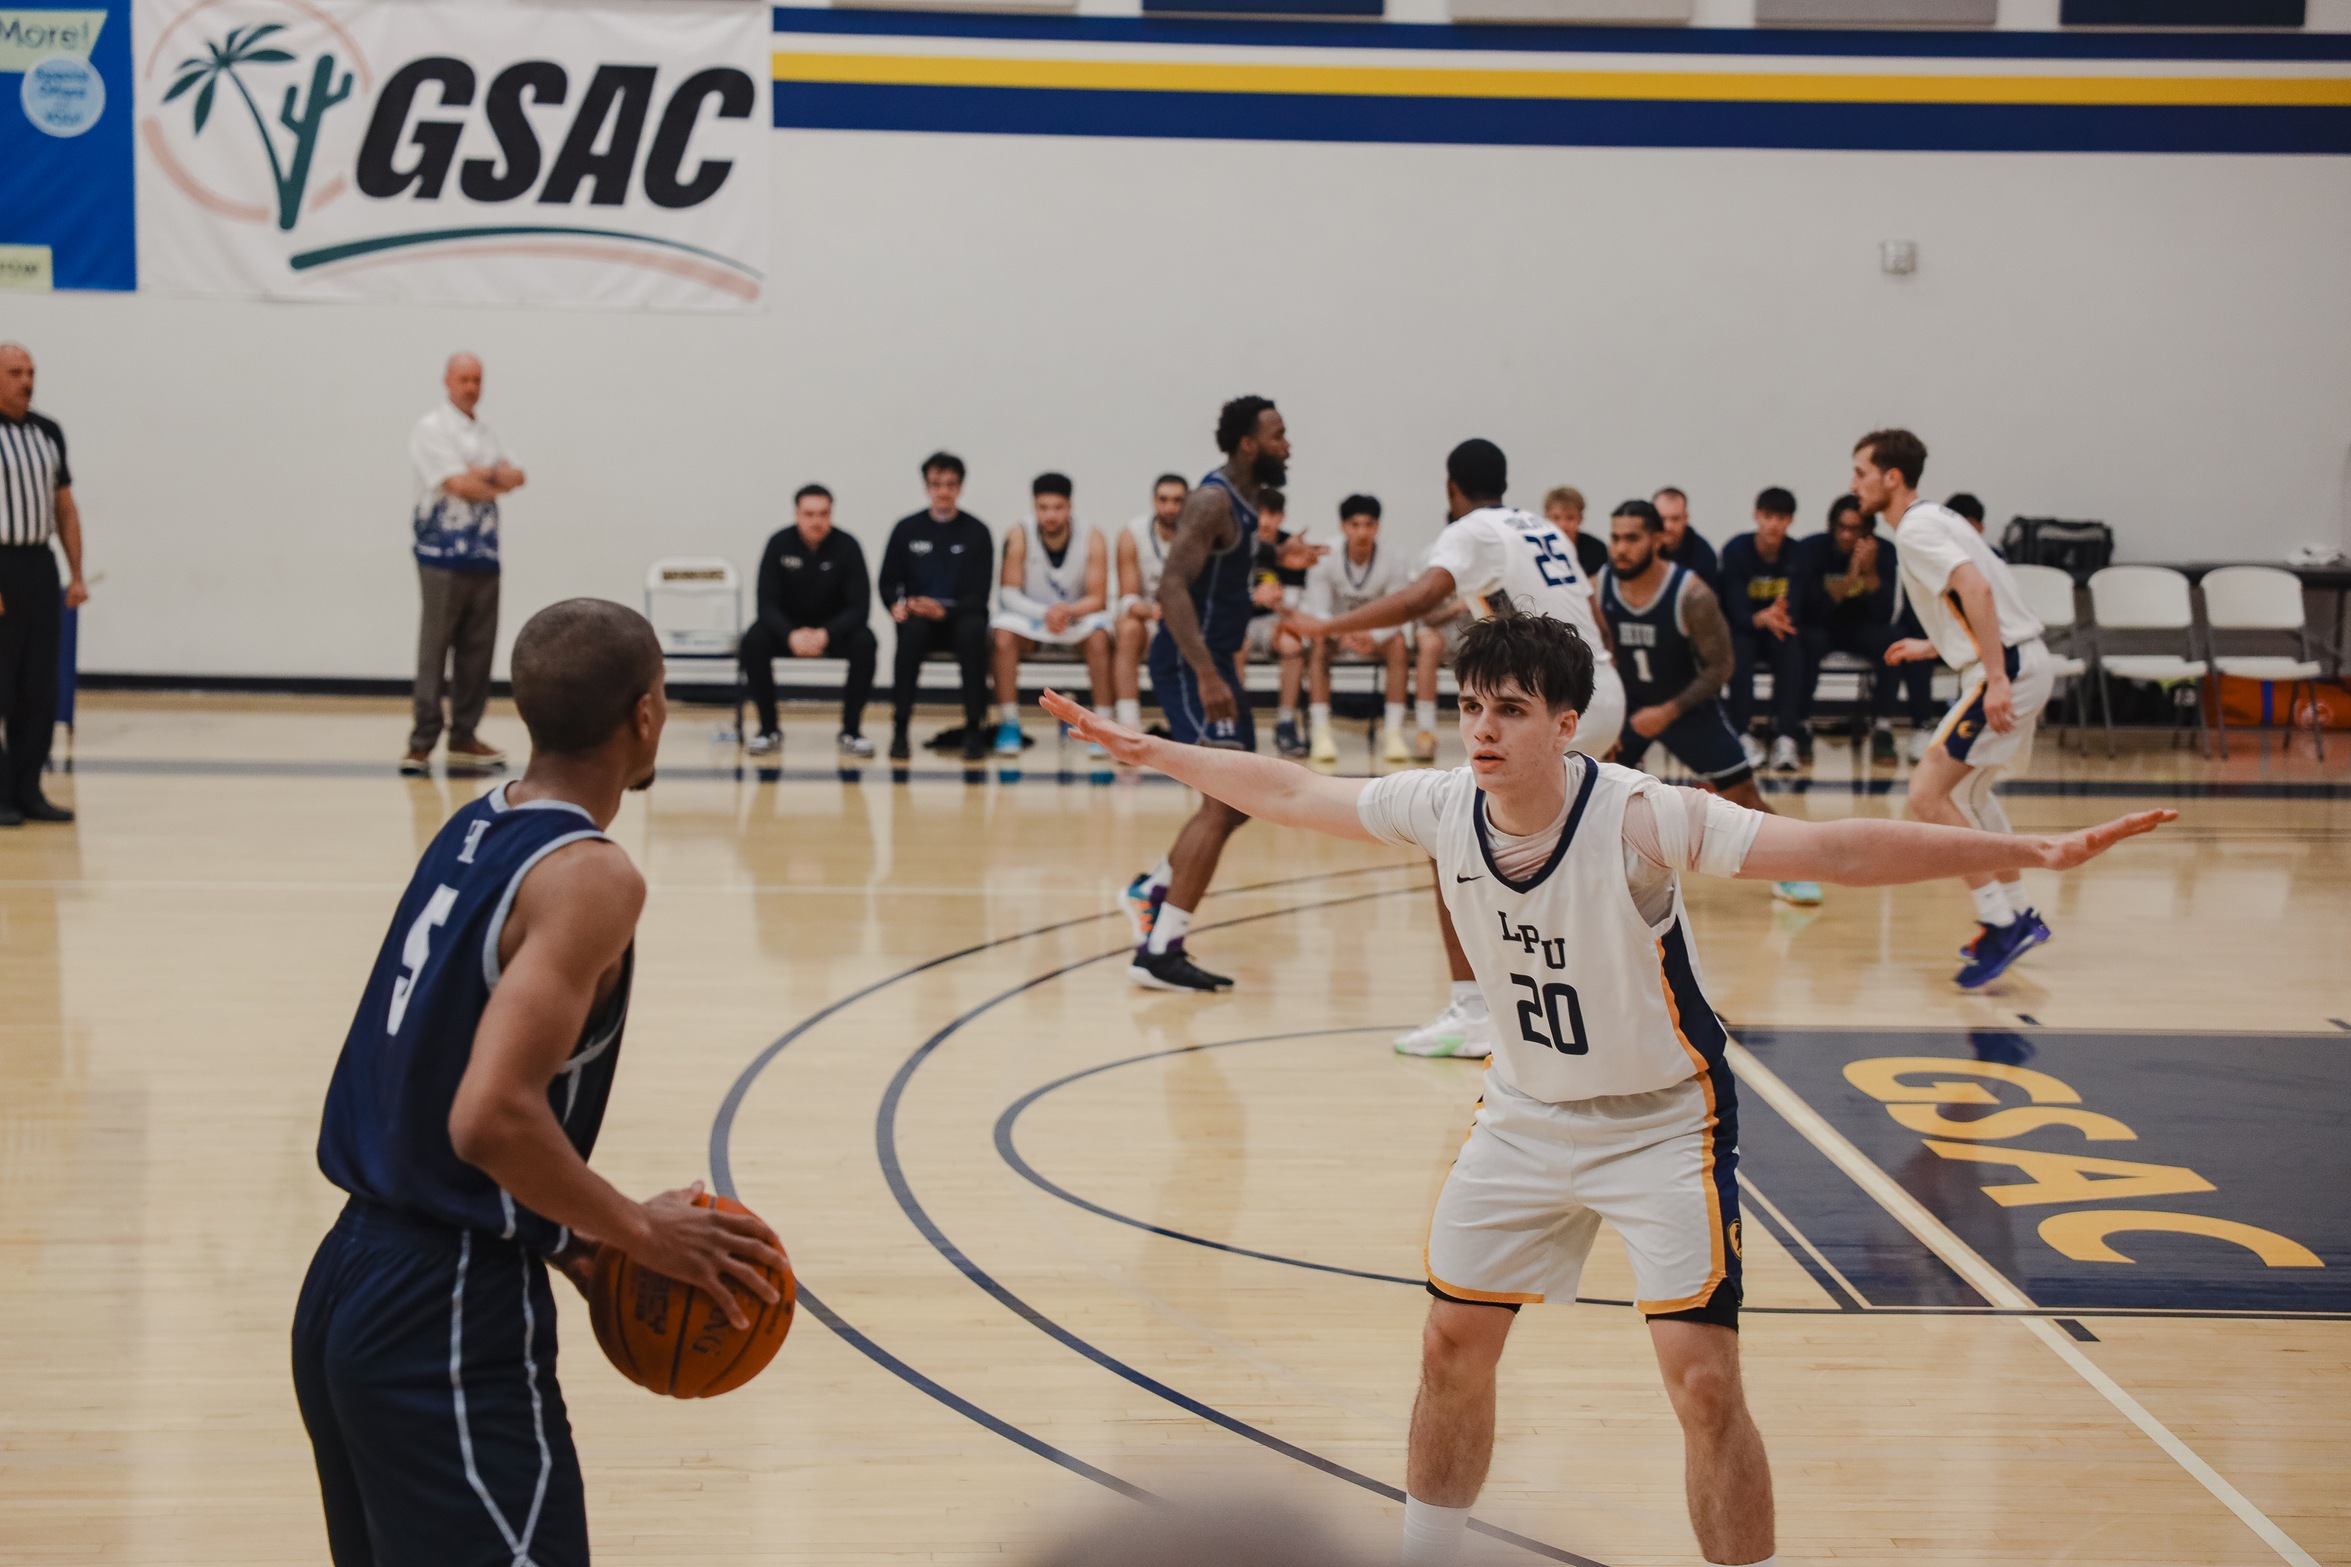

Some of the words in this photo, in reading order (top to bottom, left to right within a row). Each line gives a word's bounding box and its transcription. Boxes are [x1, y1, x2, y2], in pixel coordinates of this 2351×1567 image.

[356, 57, 755, 209] GSAC
[1523, 533, 1577, 587] 25
[1633, 648, 1653, 682] 1
[387, 883, 460, 1037] 5
[1497, 910, 1566, 970] LPU
[1510, 972, 1590, 1056] 20
[1842, 1056, 2326, 1268] GSAC
